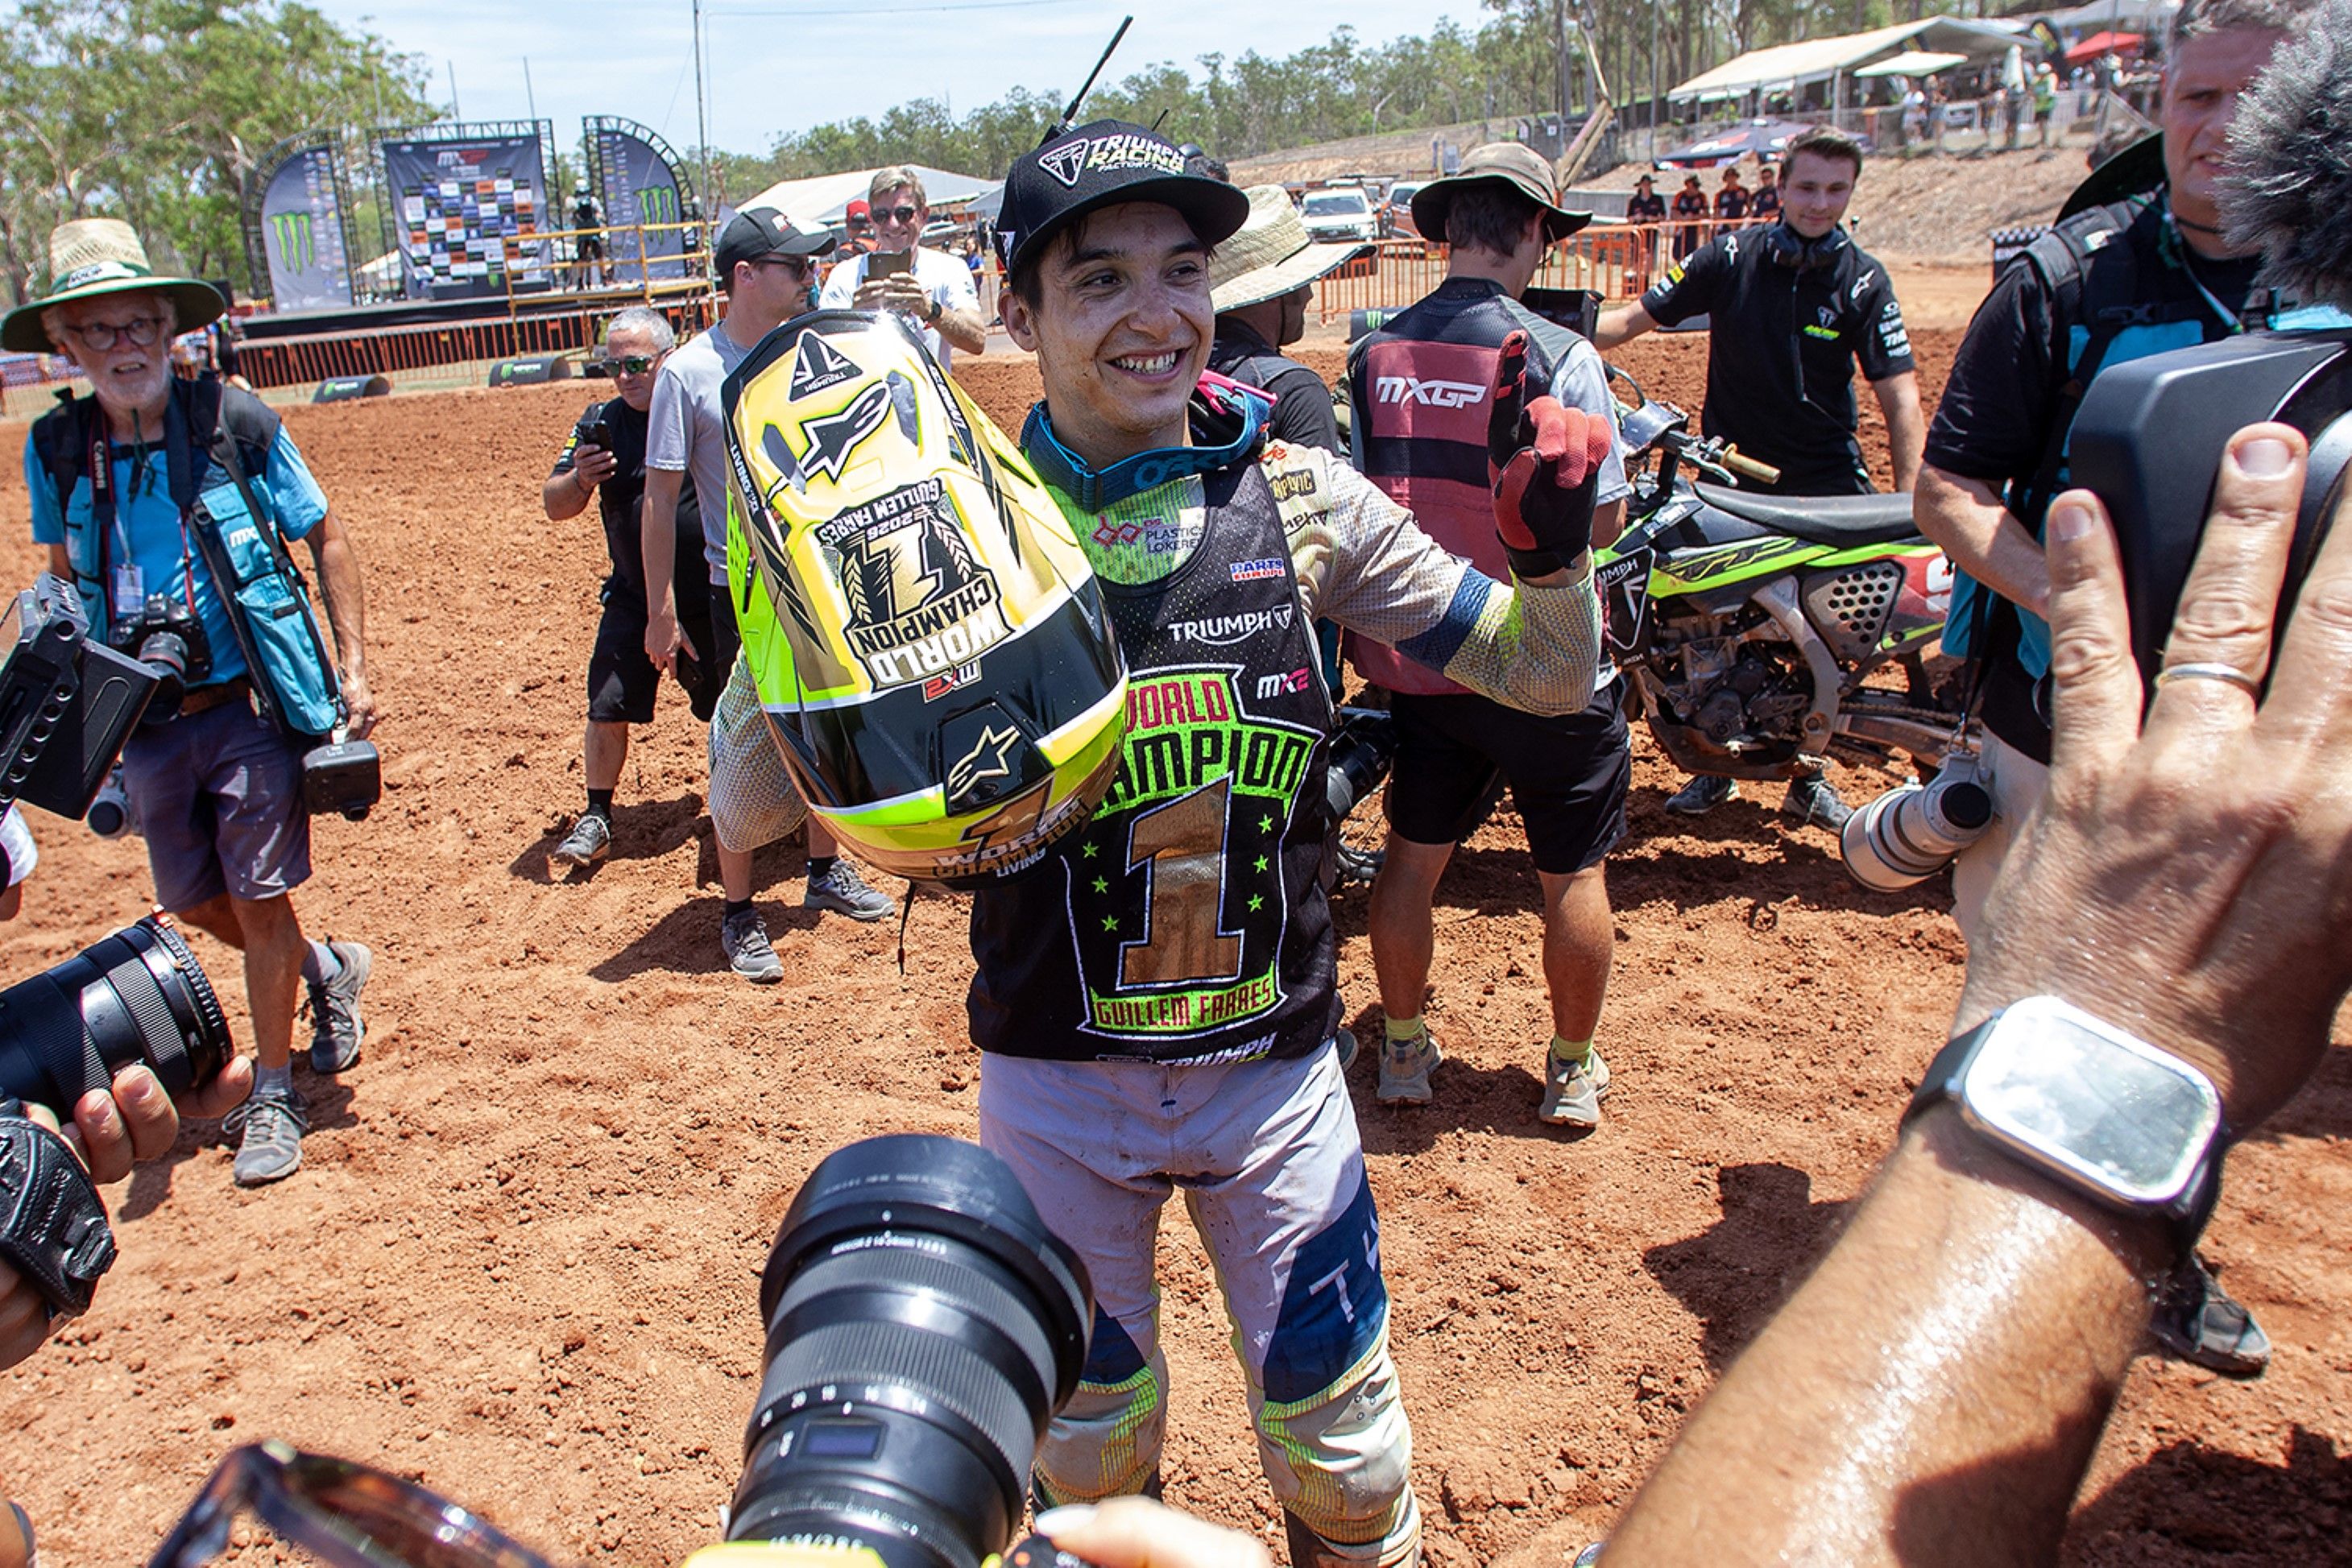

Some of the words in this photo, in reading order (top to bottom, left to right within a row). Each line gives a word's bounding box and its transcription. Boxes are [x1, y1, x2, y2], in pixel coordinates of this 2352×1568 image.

[1086, 148, 1184, 173] RACING
[1090, 134, 1185, 163] TRIUMPH
[1375, 376, 1487, 410] MXGP
[872, 479, 941, 519] GUILLEM
[818, 506, 874, 547] FARRES
[867, 511, 914, 540] 2026
[1232, 558, 1284, 574] PARTS
[1234, 570, 1285, 581] EUROPE
[1597, 559, 1638, 581] UMPH
[855, 577, 992, 654] CHAMPION
[1169, 610, 1272, 644] TRIUMPH
[869, 604, 1007, 685] WORLD
[926, 662, 978, 700] MX2
[1257, 667, 1311, 699] MX2
[1105, 730, 1307, 805] AMPION
[934, 805, 1090, 878] CHAMPION
[936, 795, 1082, 865] WORLD
[996, 847, 1046, 878] LIVING
[1116, 771, 1244, 991] 1
[1096, 995, 1190, 1027] GUILLEM
[1199, 978, 1271, 1023] FARRES
